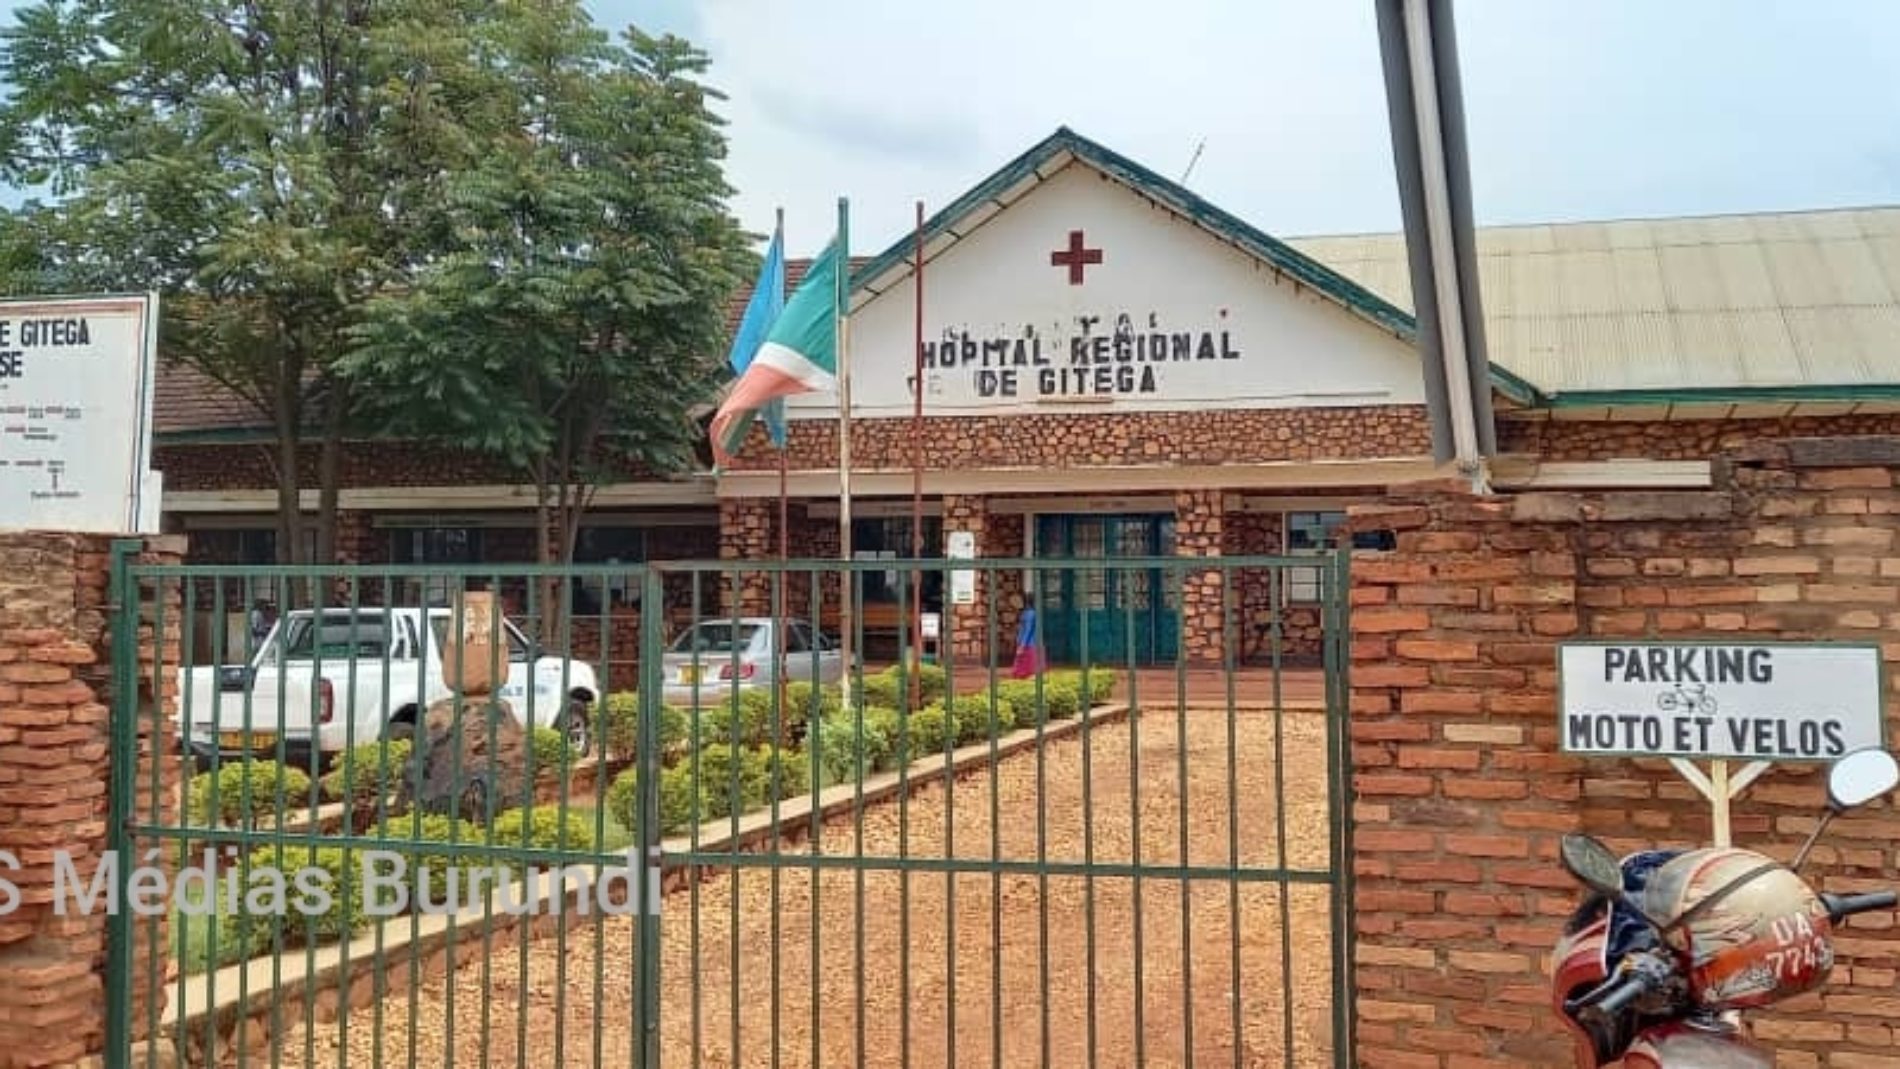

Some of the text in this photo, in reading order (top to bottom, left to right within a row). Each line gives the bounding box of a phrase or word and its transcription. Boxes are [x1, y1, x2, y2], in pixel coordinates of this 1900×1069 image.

[21, 318, 91, 347] GITEGA
[1071, 331, 1240, 364] REGIONAL
[976, 369, 1018, 397] DE
[1039, 365, 1156, 396] GITEGA
[1604, 648, 1773, 683] PARKING
[1569, 714, 1846, 756] MOTO ET VELOS
